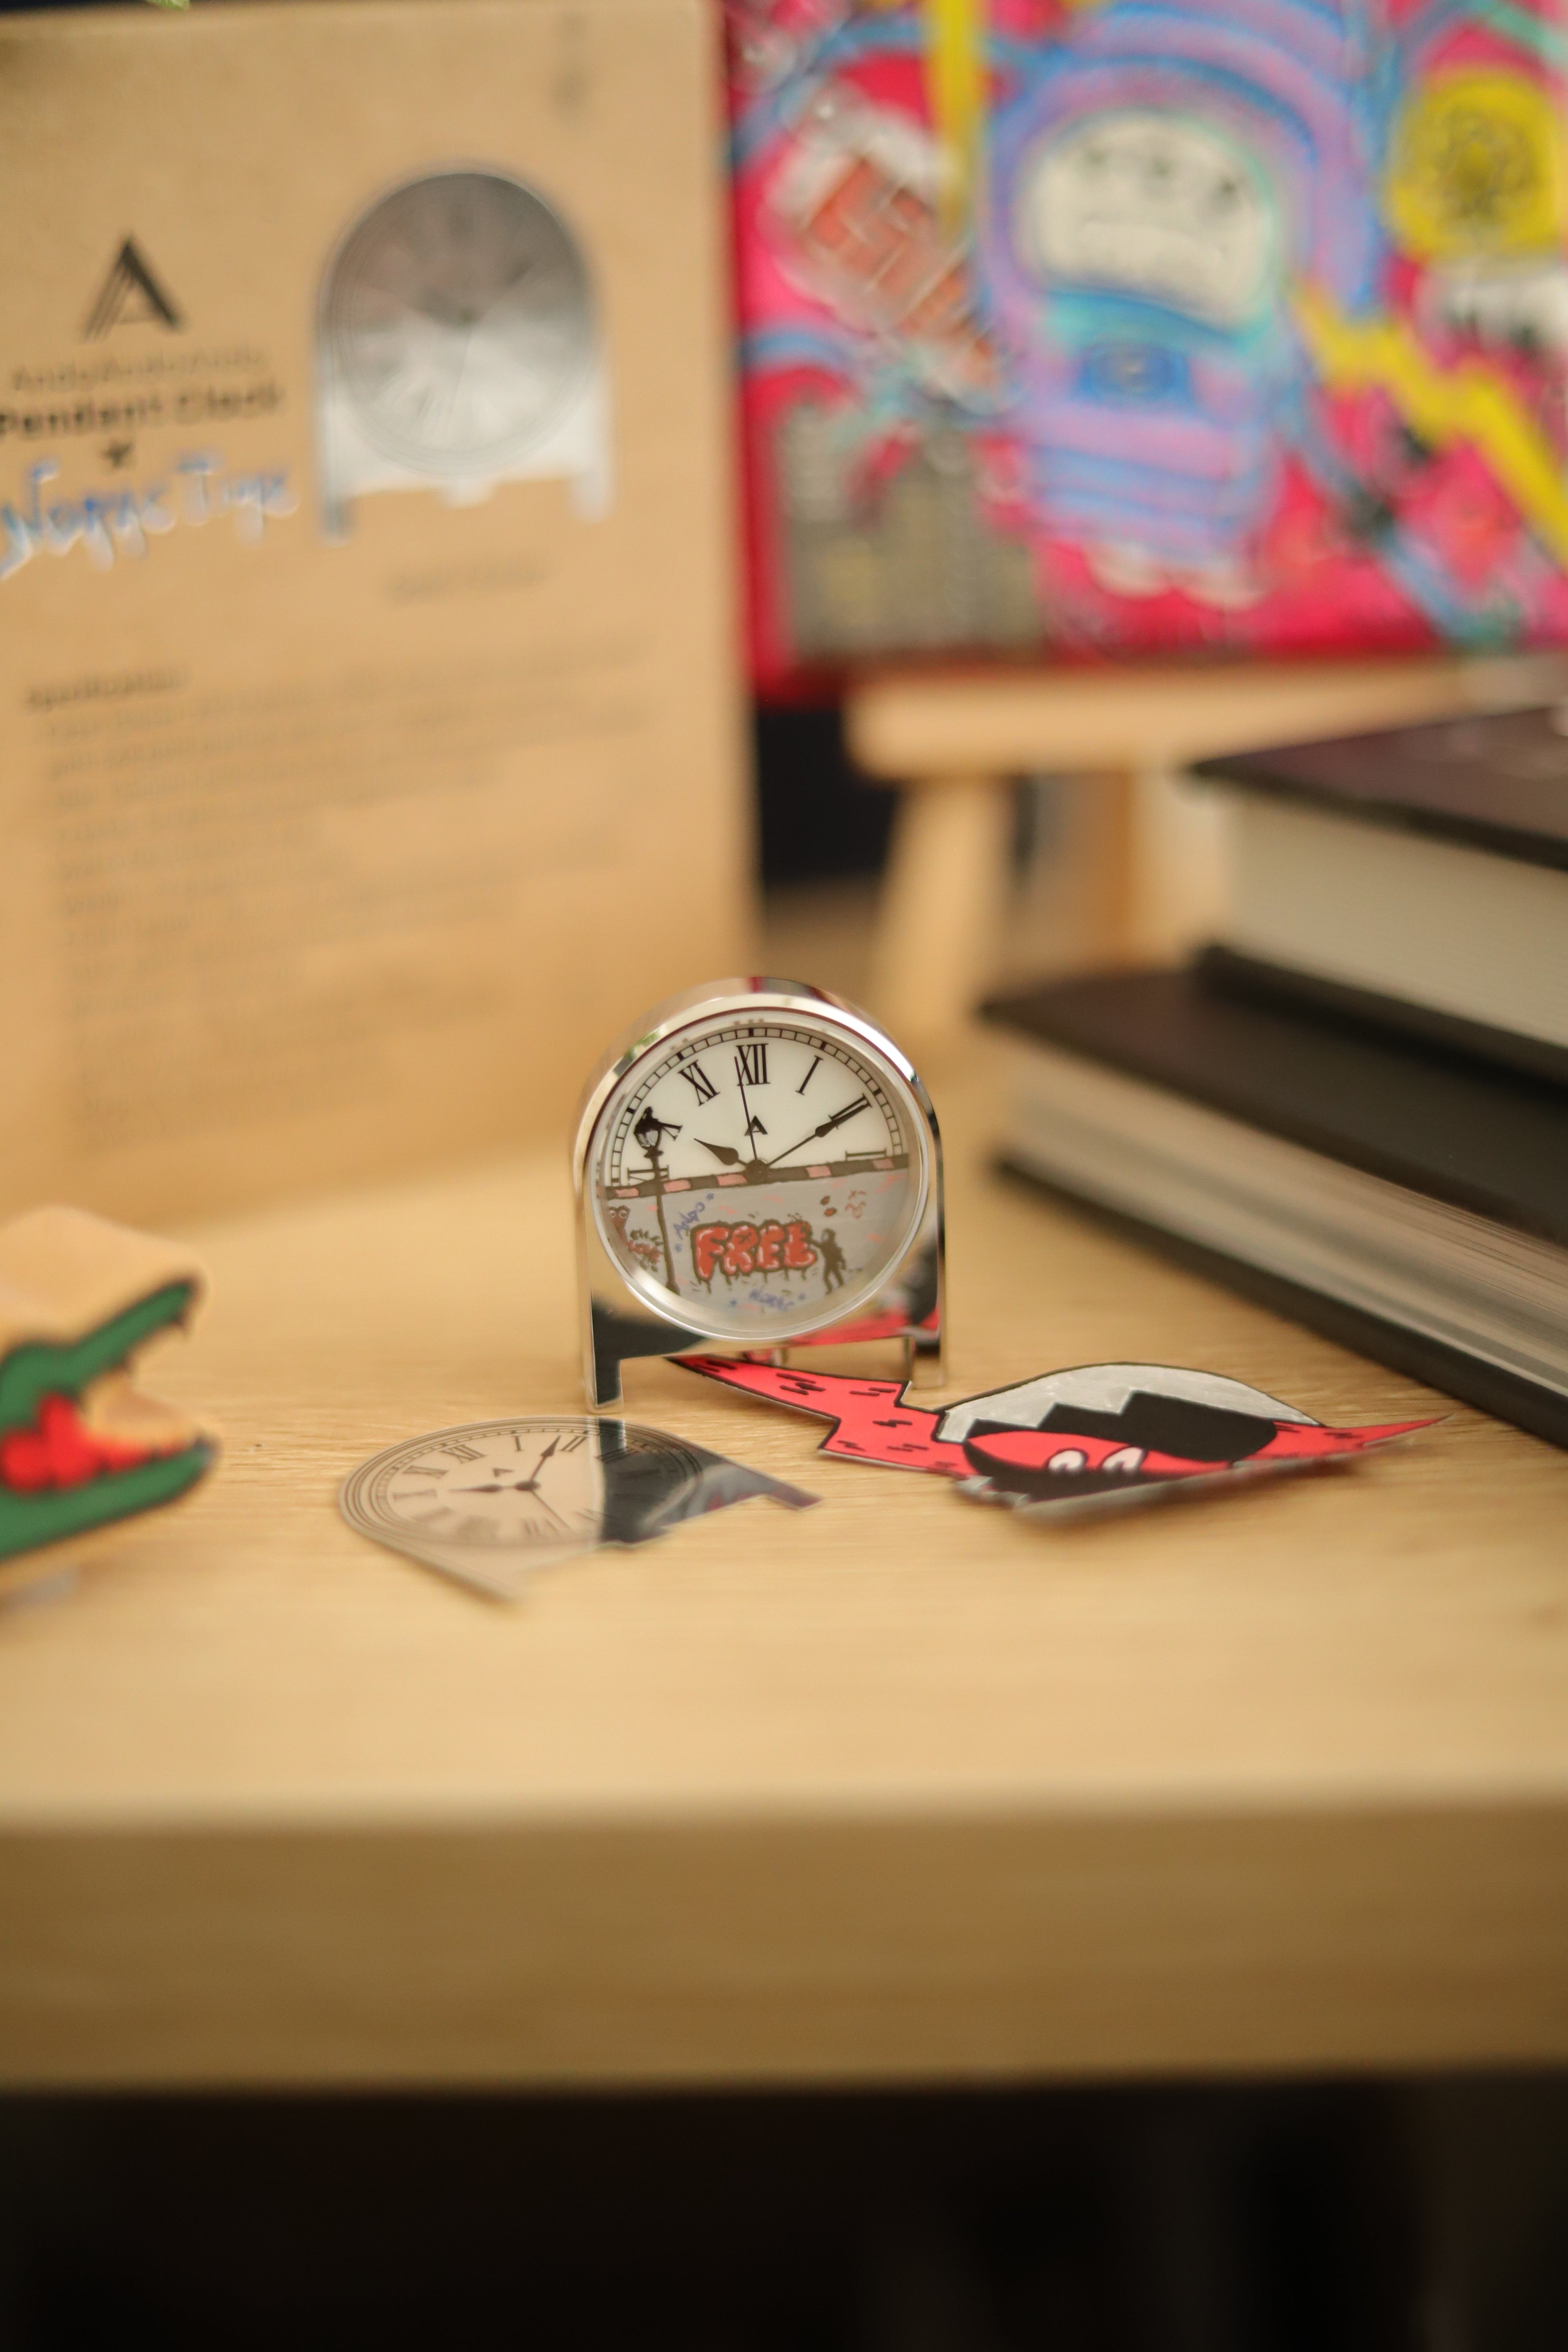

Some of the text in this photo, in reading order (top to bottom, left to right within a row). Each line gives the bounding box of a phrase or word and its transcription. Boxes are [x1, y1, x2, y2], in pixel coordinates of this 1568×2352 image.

[678, 1060, 720, 1106] XI
[735, 1043, 771, 1086] XII
[795, 1055, 824, 1096] I
[690, 1218, 818, 1283] FREE
